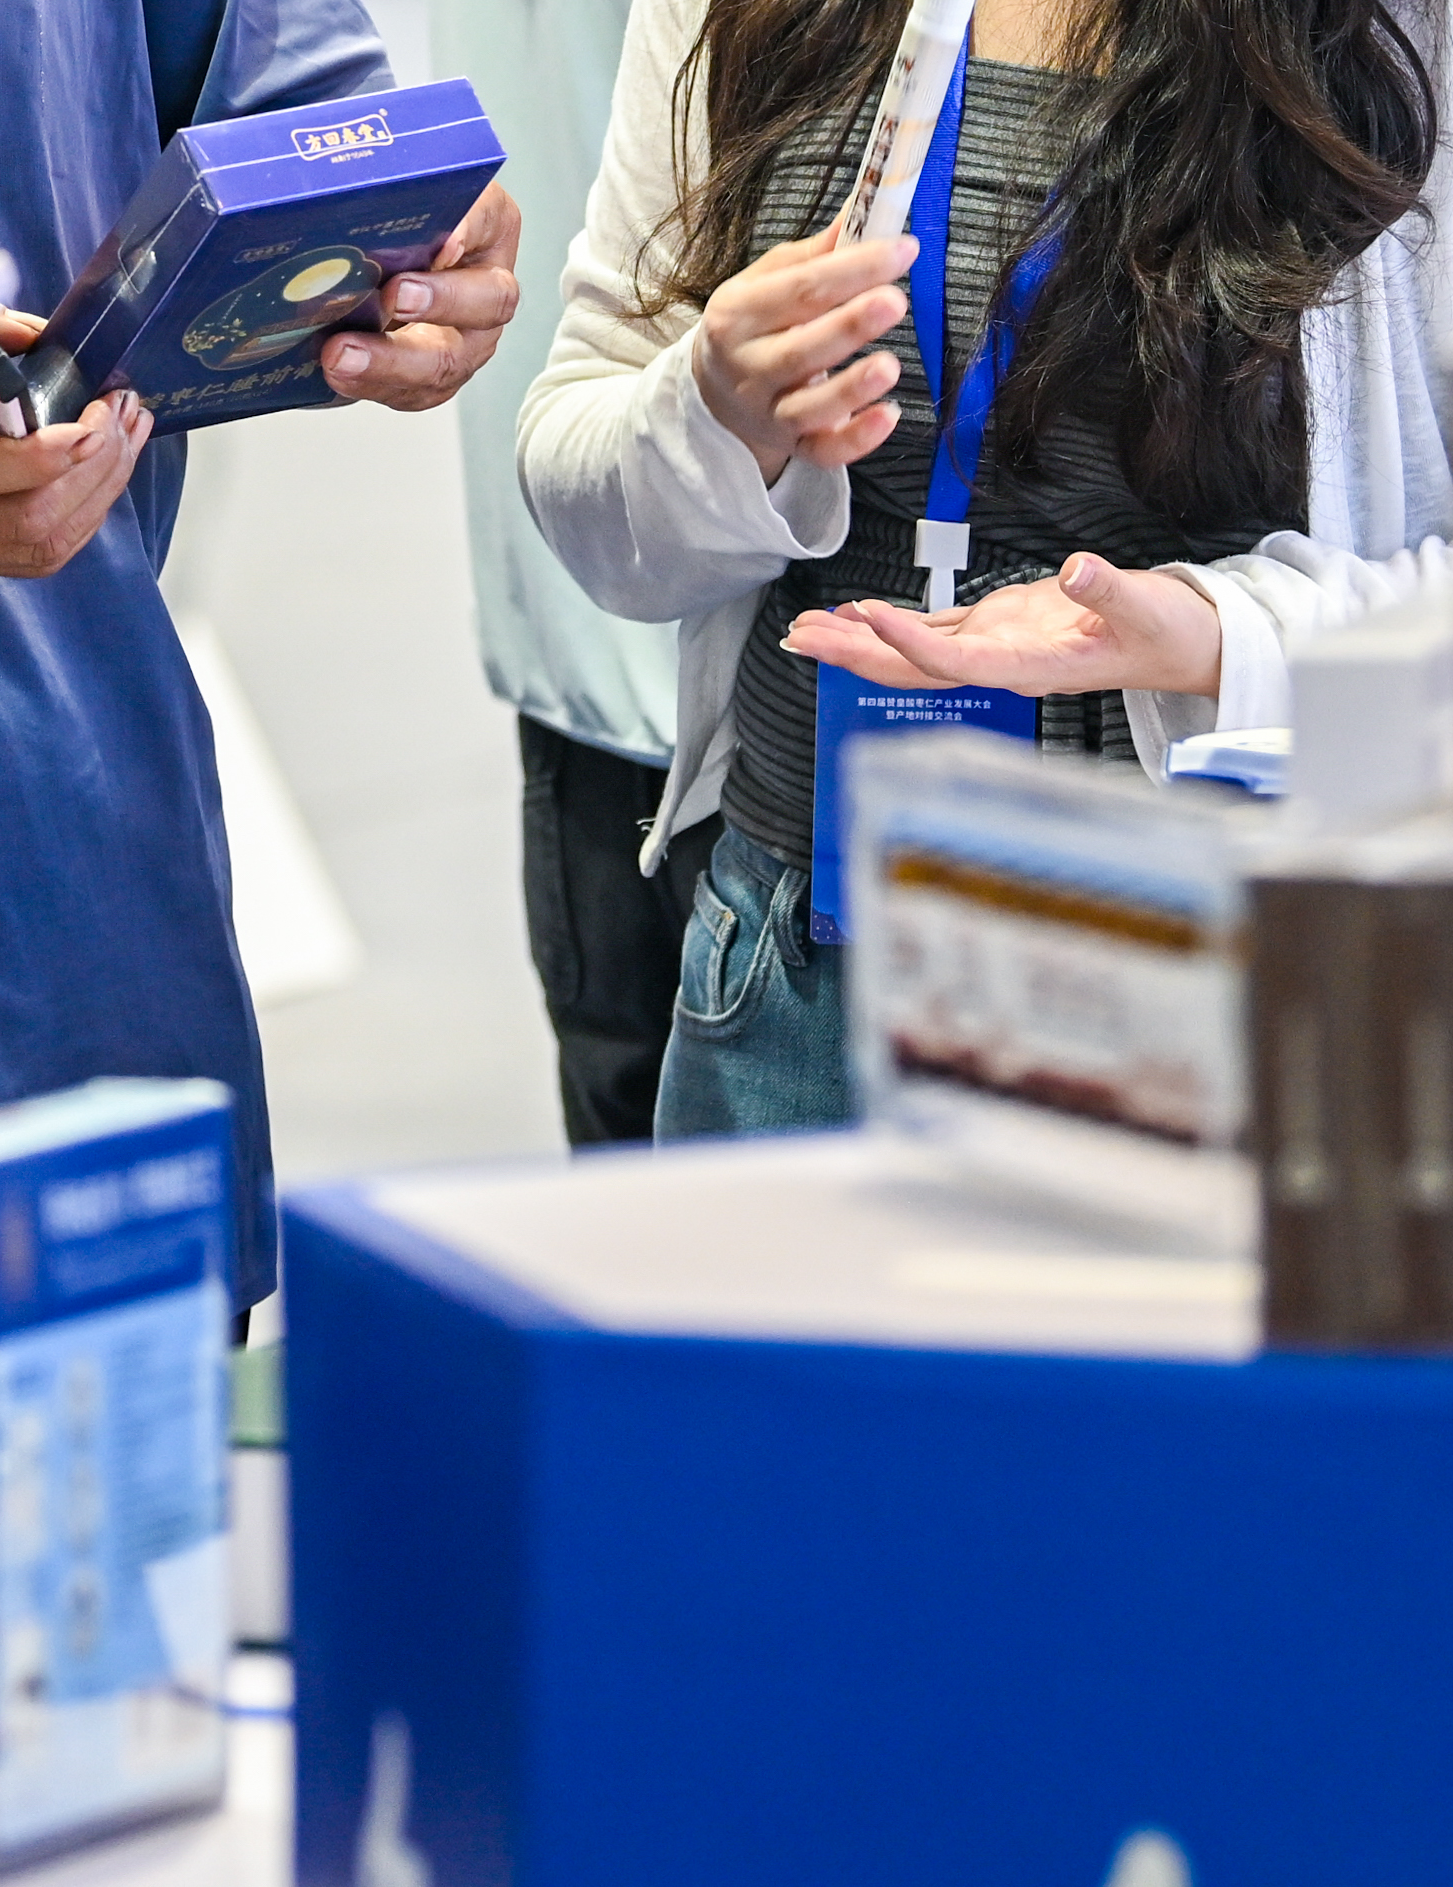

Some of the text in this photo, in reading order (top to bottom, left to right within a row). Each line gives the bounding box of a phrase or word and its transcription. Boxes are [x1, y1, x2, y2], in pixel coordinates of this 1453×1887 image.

[304, 123, 376, 153] 方回春堂
[857, 697, 992, 709] 第四届赞皇酸枣仁产业发展大会
[885, 710, 963, 722] 暨产地对接交流会
